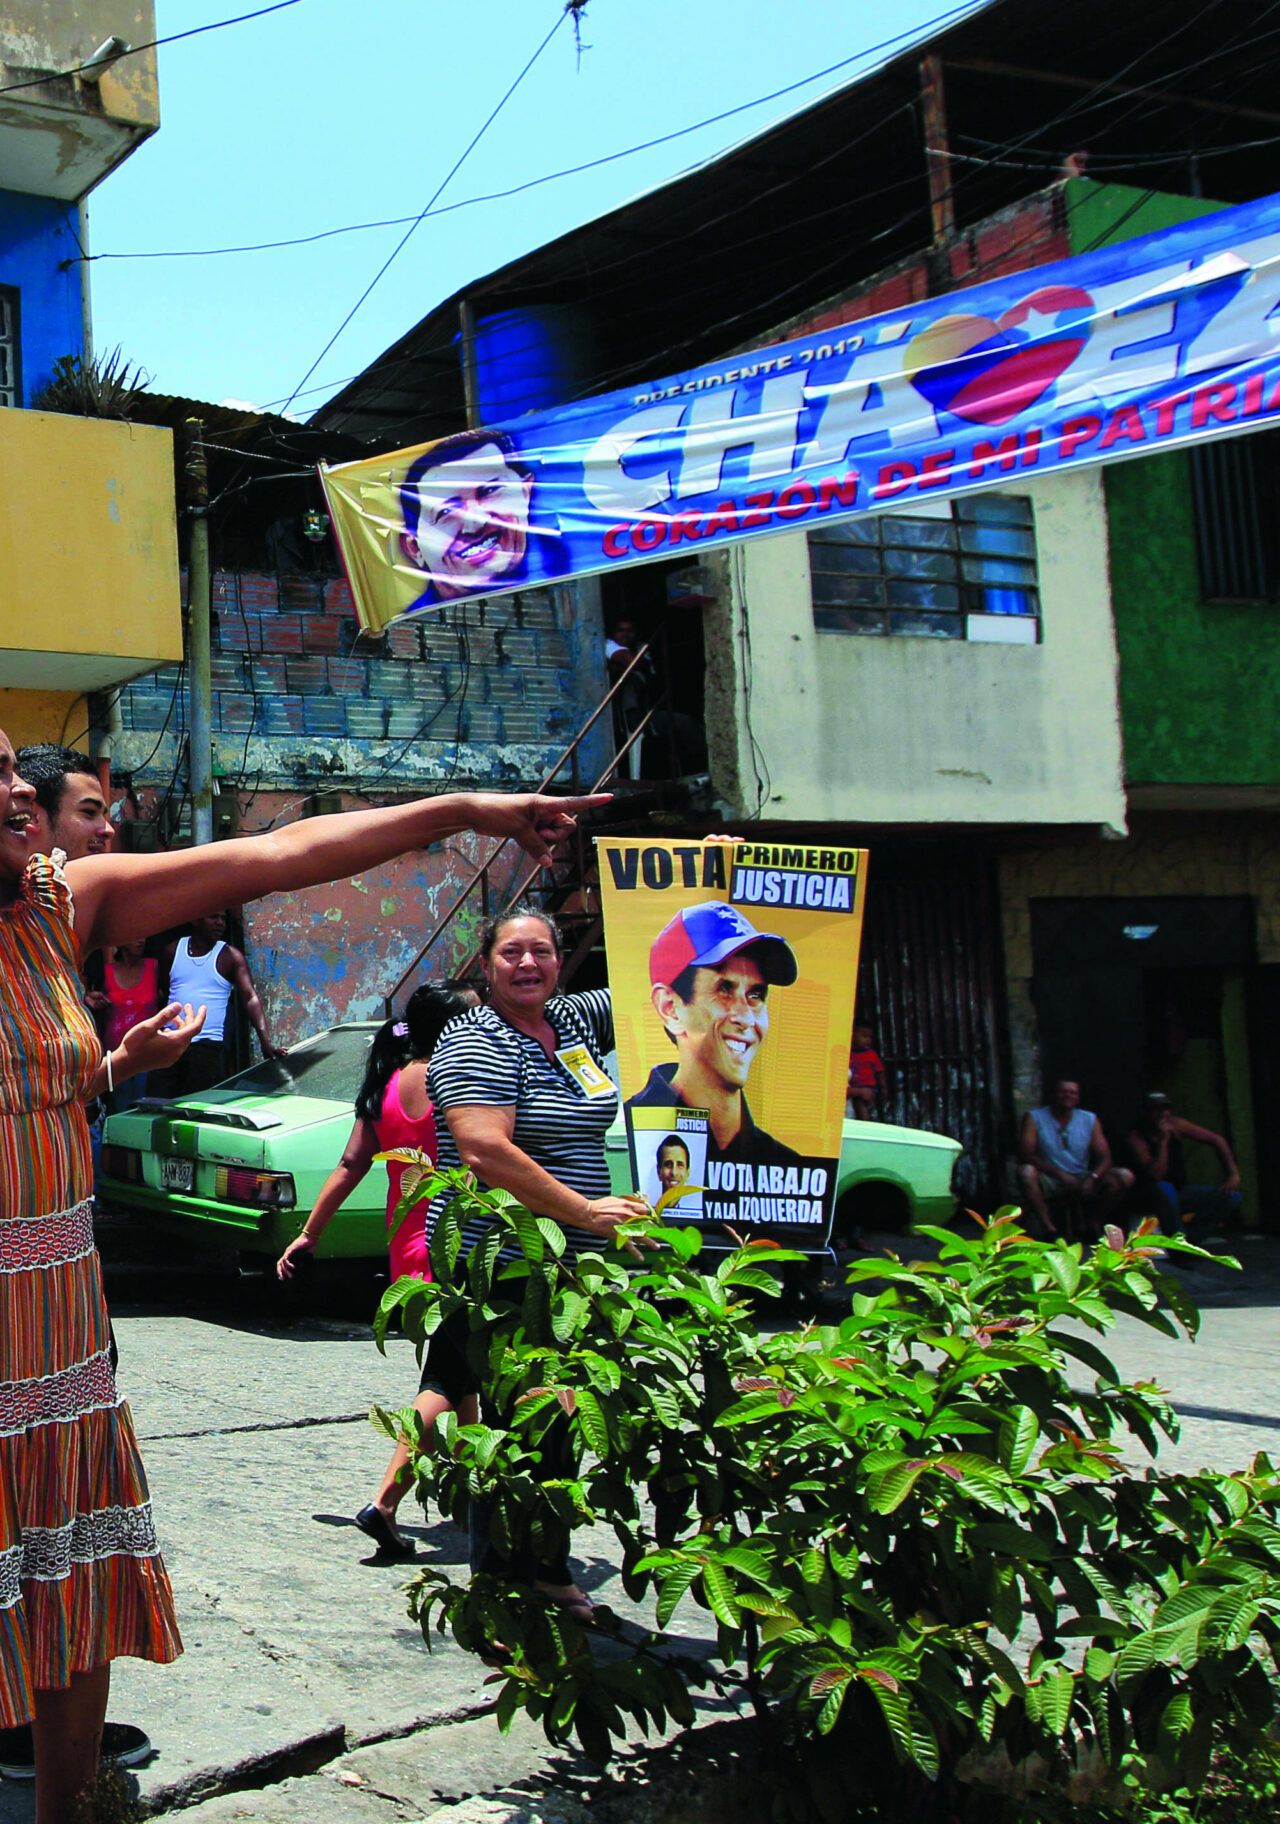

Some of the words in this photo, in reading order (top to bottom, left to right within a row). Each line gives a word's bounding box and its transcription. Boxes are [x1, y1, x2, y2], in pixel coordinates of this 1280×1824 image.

[602, 470, 861, 558] CORAZÓN
[873, 449, 955, 500] DE
[968, 428, 1042, 478] MI
[606, 845, 727, 890] VOTA
[735, 844, 855, 872] PRIMERO
[733, 868, 851, 908] JUSTICIA
[676, 1117, 708, 1132] JUSTICIA
[707, 1161, 755, 1193] VOTA
[757, 1165, 828, 1197] ABAJO
[738, 1196, 823, 1224] IZQUIERDA
